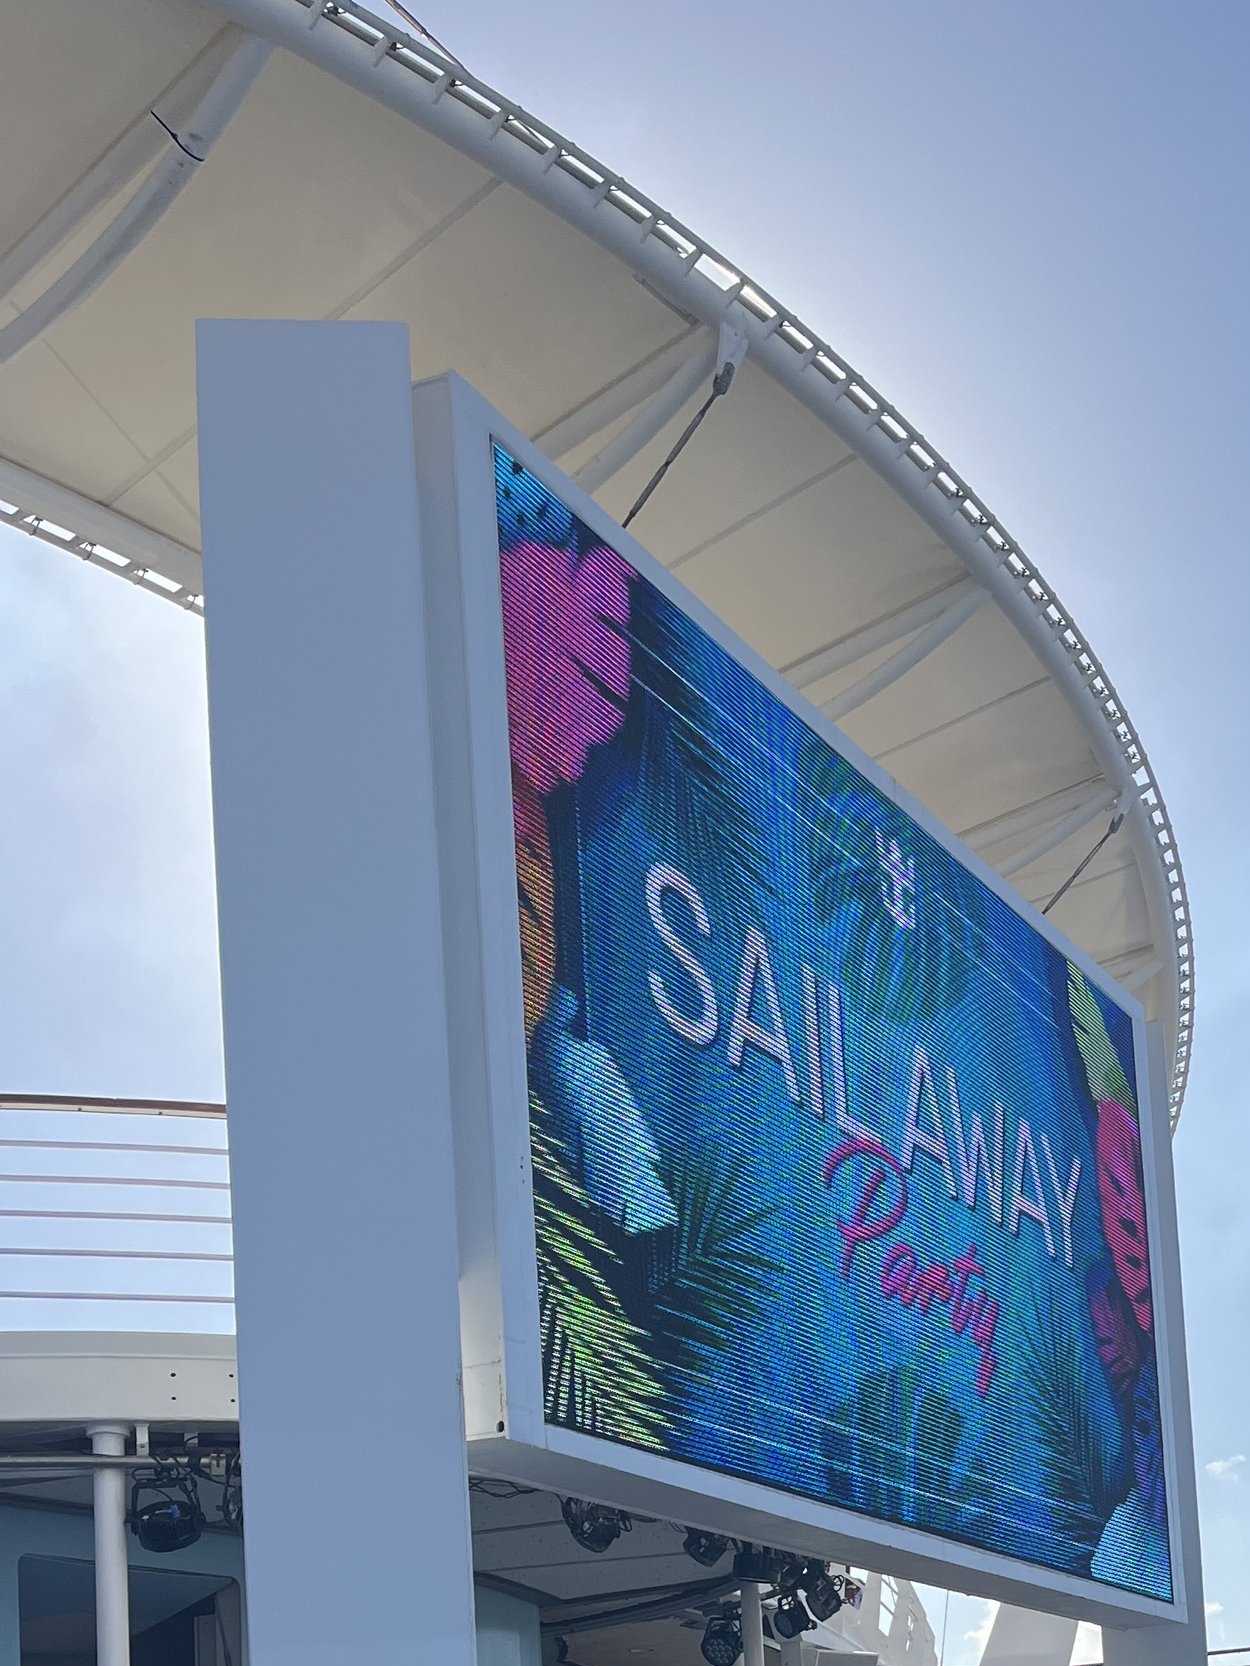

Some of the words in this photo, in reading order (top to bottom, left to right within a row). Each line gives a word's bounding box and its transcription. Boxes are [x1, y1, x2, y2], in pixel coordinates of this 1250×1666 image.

[647, 861, 882, 1145] SAIL
[903, 1044, 1083, 1269] AWAY
[823, 1138, 999, 1397] Party
